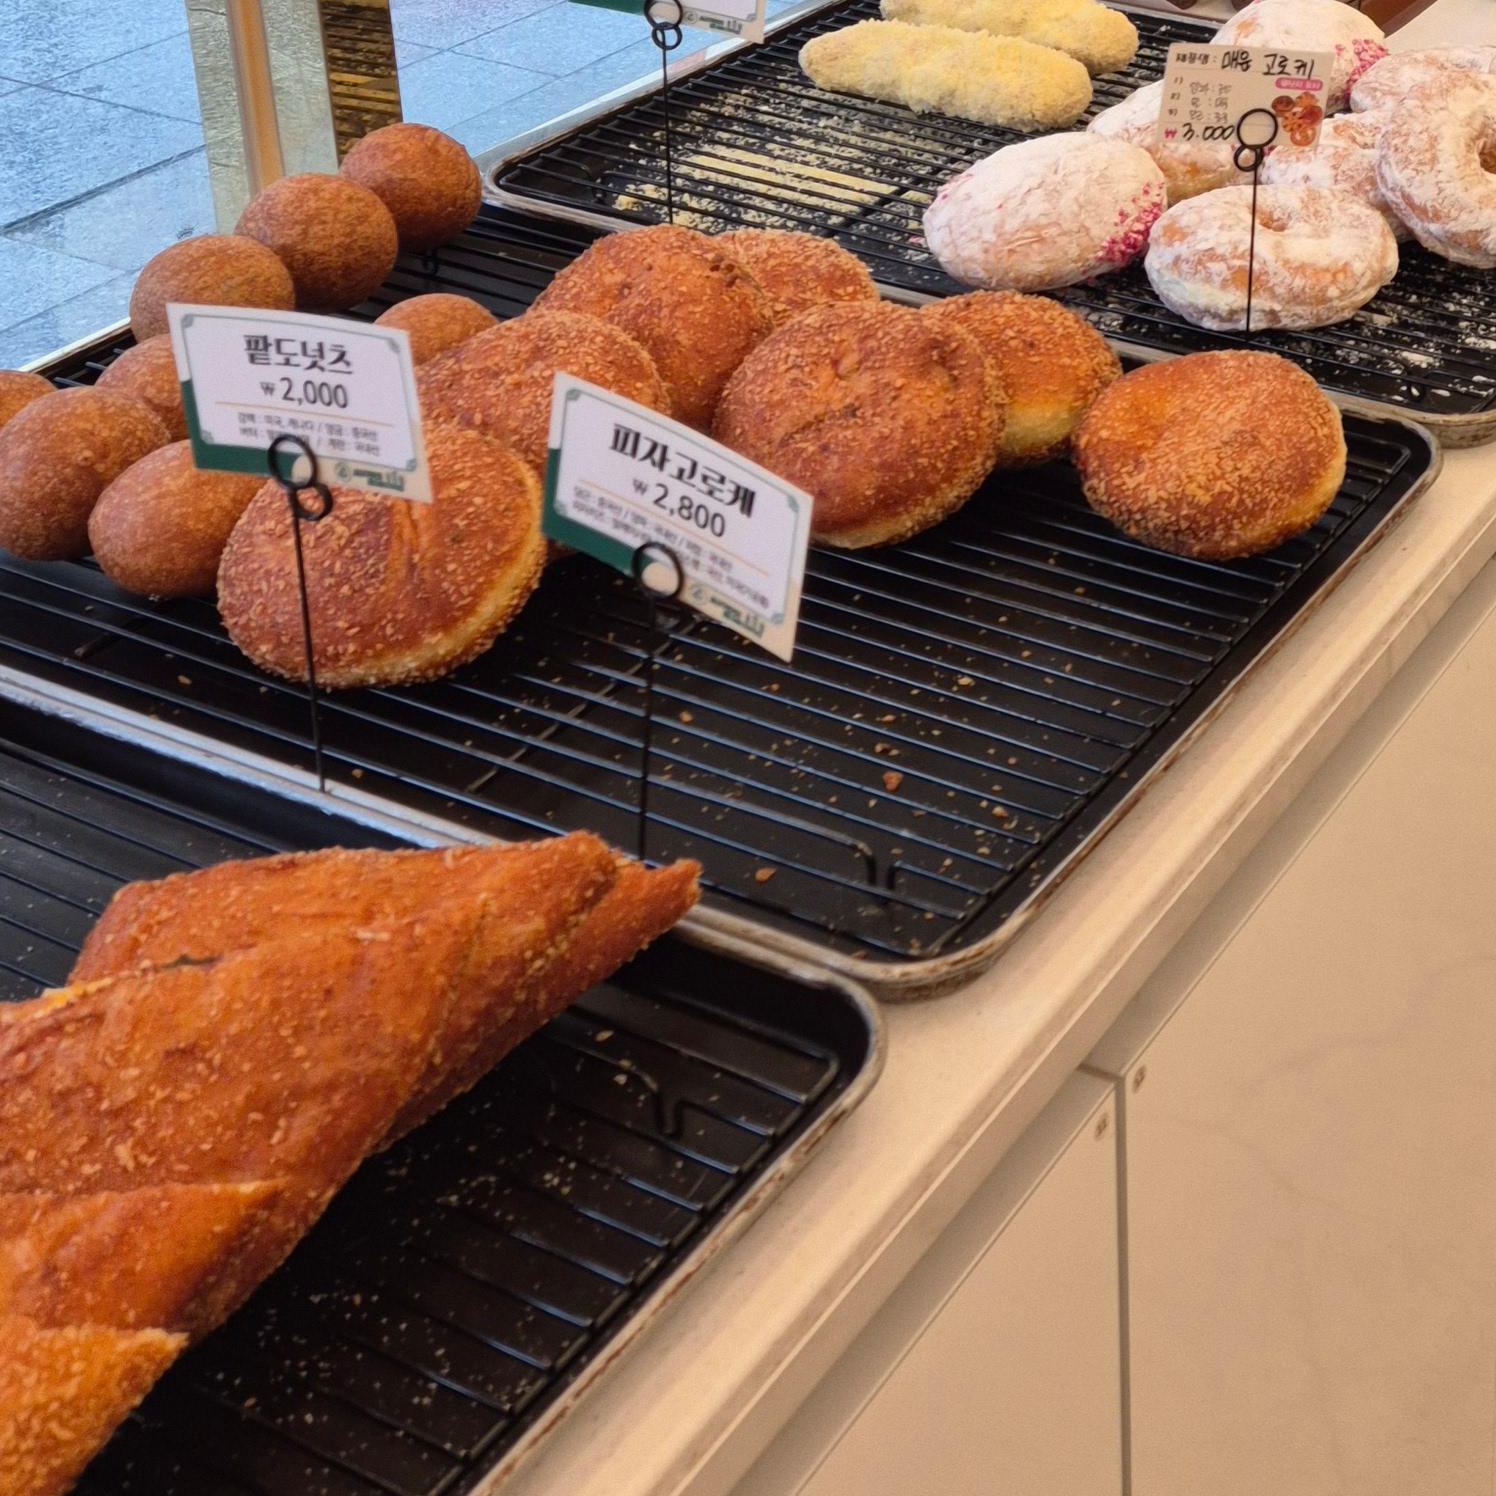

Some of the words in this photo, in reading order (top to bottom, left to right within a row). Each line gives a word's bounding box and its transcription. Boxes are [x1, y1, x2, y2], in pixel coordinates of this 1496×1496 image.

[243, 334, 354, 375] 팥도넛츠
[280, 377, 349, 409] 2,000
[609, 423, 756, 519] 피자고로케
[653, 483, 726, 538] 2,800
